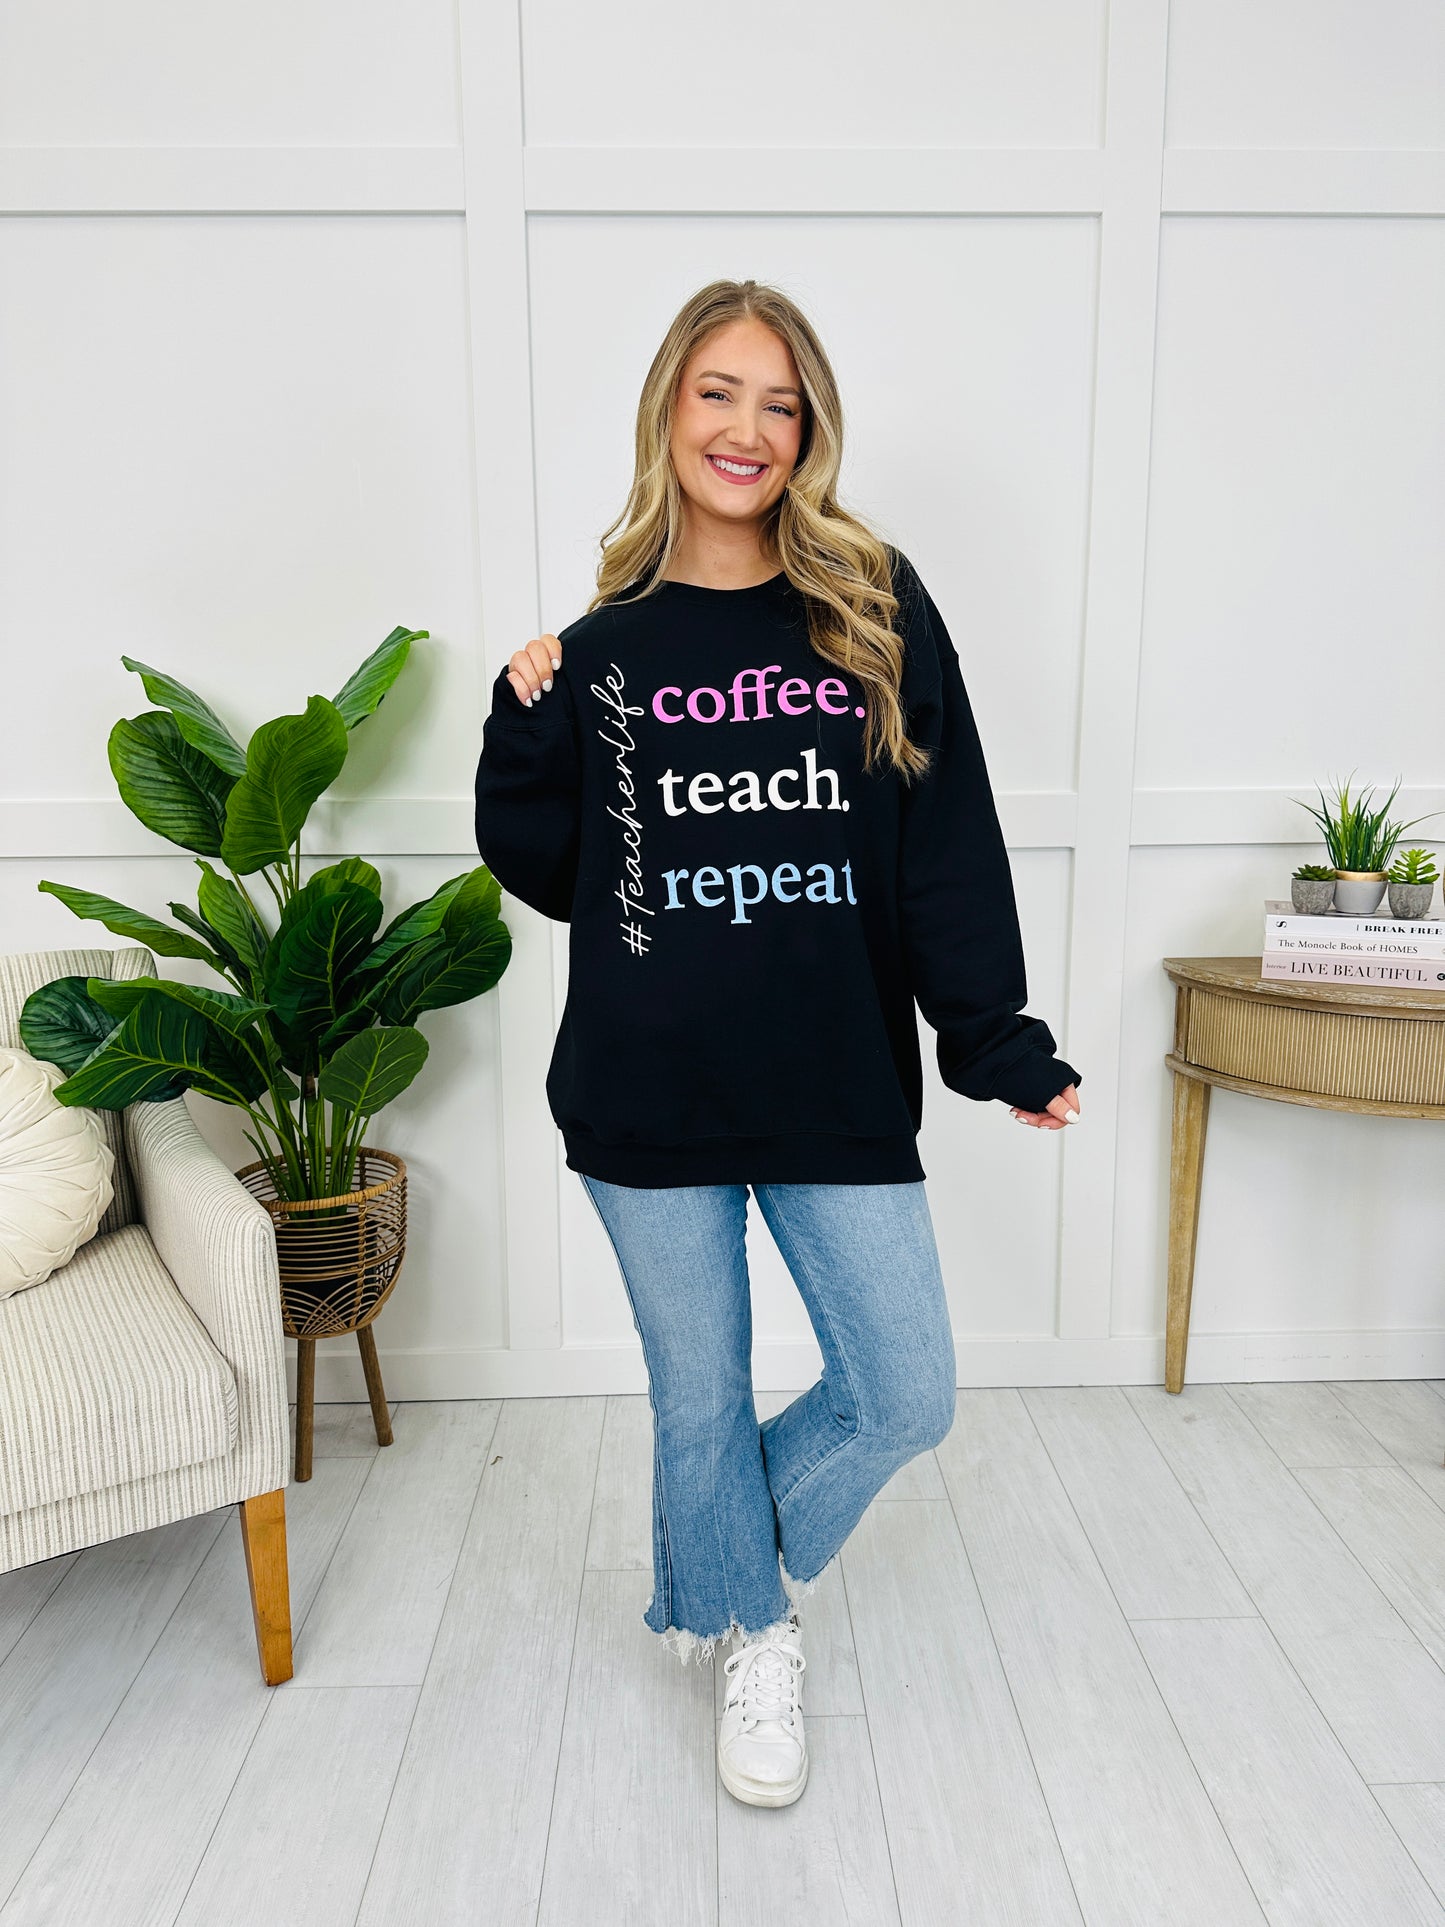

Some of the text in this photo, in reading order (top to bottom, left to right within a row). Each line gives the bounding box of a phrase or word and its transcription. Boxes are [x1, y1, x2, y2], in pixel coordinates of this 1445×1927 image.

[651, 664, 866, 724] coffee.
[657, 747, 850, 817] teach.
[661, 858, 858, 925] repeat
[1278, 939, 1419, 954] The Monocle Book of HOMES
[1364, 925, 1443, 935] BREAK FREE
[1291, 961, 1328, 976] LIVE
[1333, 964, 1428, 982] BEAUTIFUL
